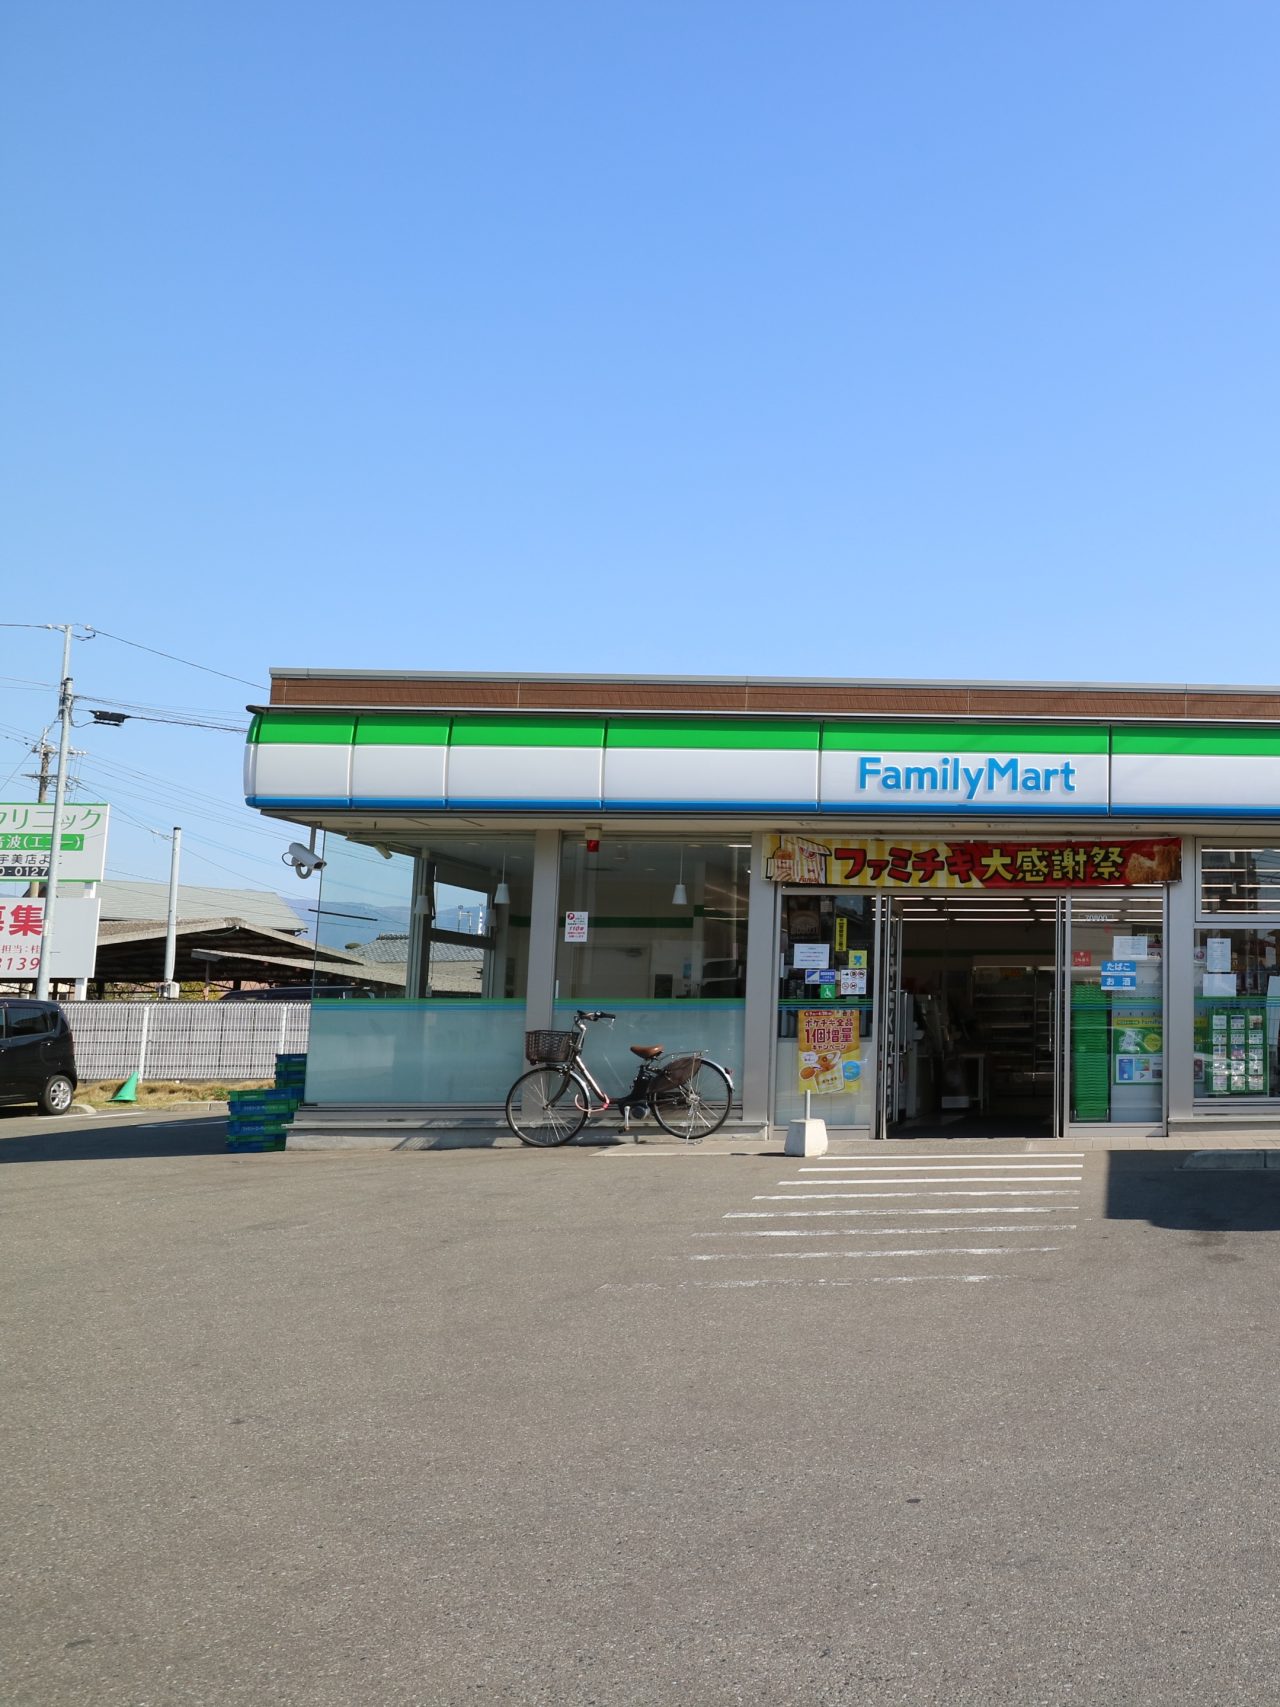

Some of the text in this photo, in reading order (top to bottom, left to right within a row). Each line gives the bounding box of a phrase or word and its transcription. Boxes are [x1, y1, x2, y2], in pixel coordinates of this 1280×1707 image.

[858, 756, 1077, 799] FamilyMart
[0, 835, 80, 849] 波(エー)
[834, 846, 1126, 883] ファミチキ大感謝祭
[0, 905, 43, 936] 集
[0, 957, 40, 971] 139
[1106, 962, 1131, 971] たばこ
[805, 1018, 854, 1027] ポケチキ全品
[805, 1028, 853, 1043] 1個増量
